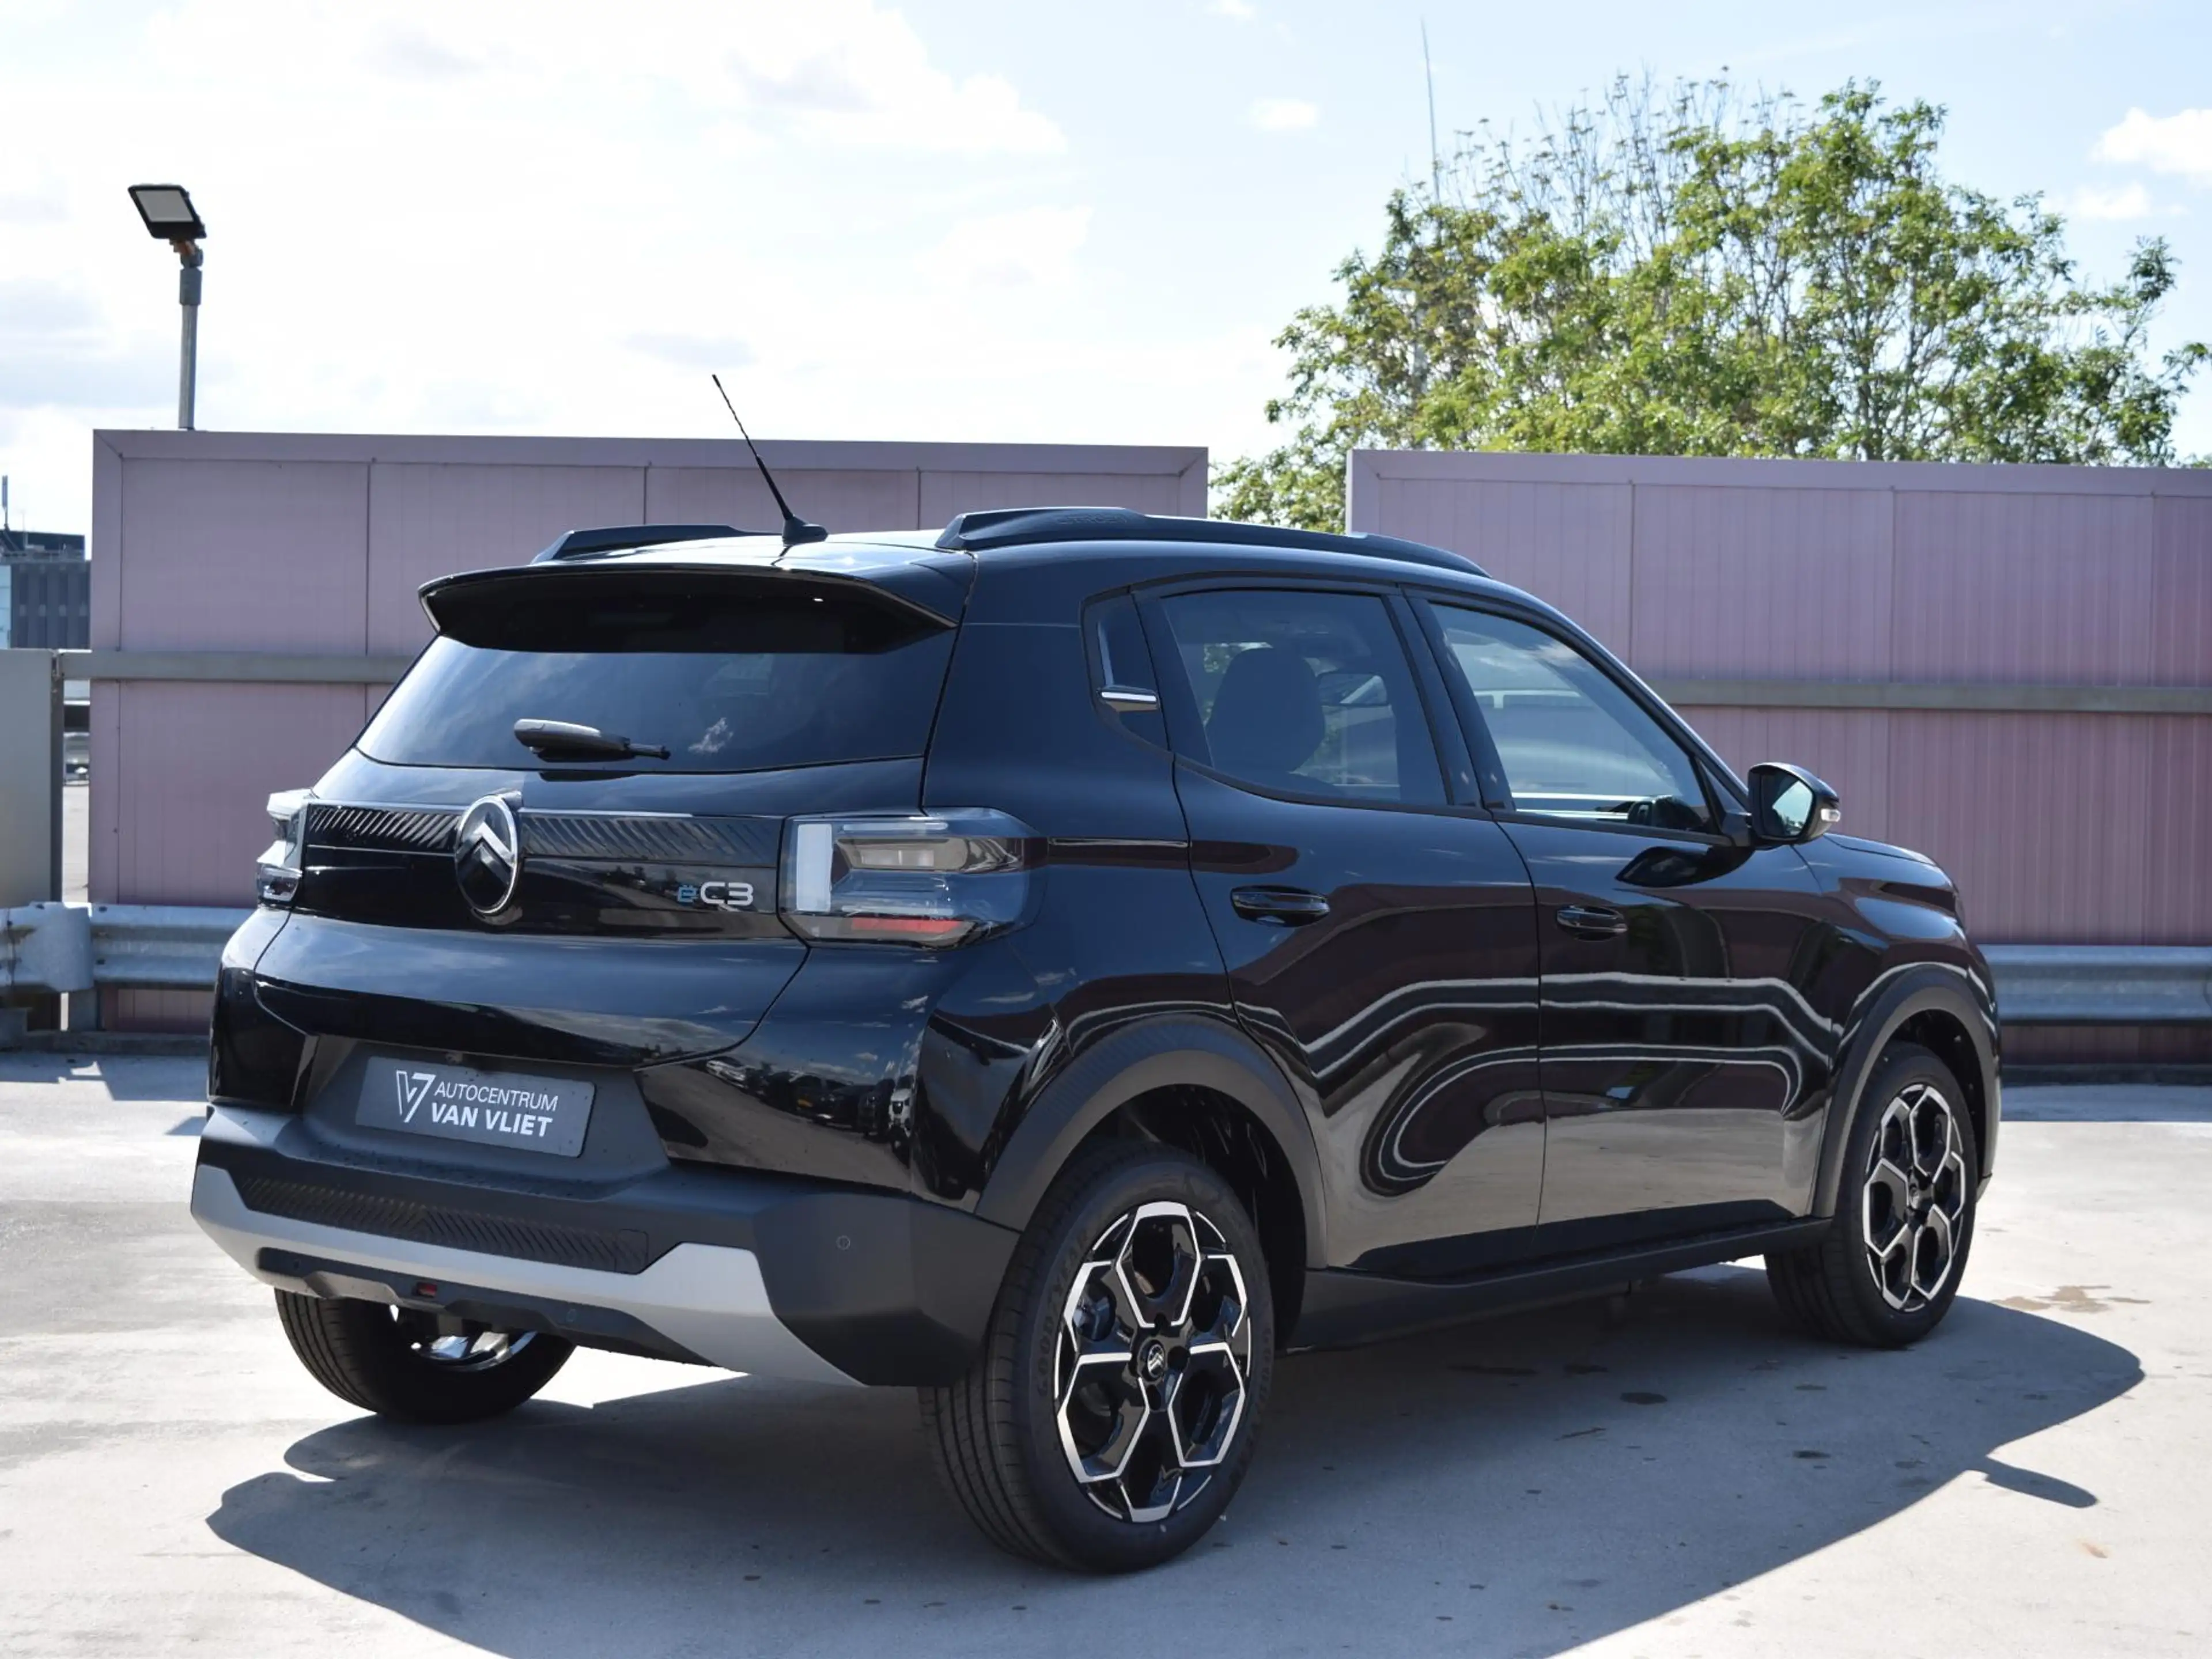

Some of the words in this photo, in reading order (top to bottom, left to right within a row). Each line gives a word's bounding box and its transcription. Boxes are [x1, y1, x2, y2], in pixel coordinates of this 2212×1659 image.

[433, 1081, 558, 1112] AUTOCENTRUM
[432, 1103, 478, 1127] VAN
[486, 1109, 553, 1138] VLIET
